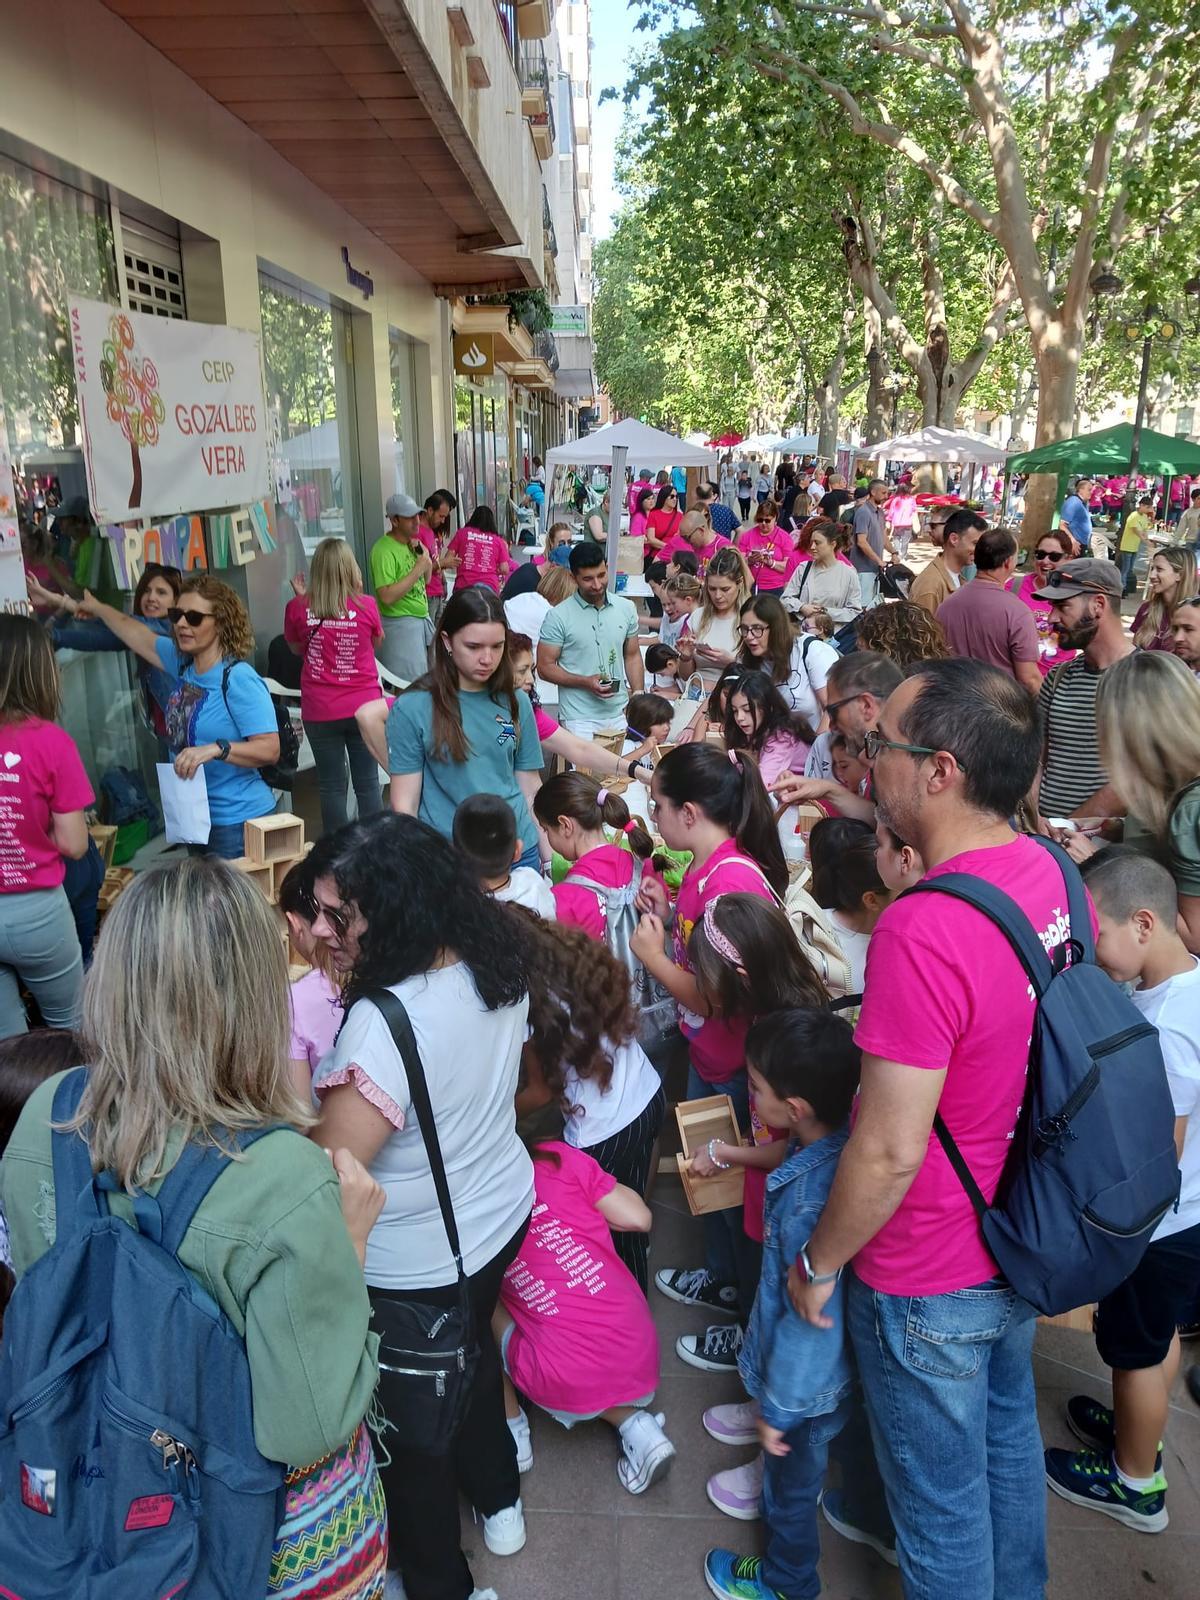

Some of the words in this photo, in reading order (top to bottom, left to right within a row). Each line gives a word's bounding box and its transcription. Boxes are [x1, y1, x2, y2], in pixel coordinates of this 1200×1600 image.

[71, 307, 87, 382] XATIVA
[201, 360, 236, 384] CEIP
[174, 404, 257, 436] GOZALBES
[201, 445, 246, 476] VERA
